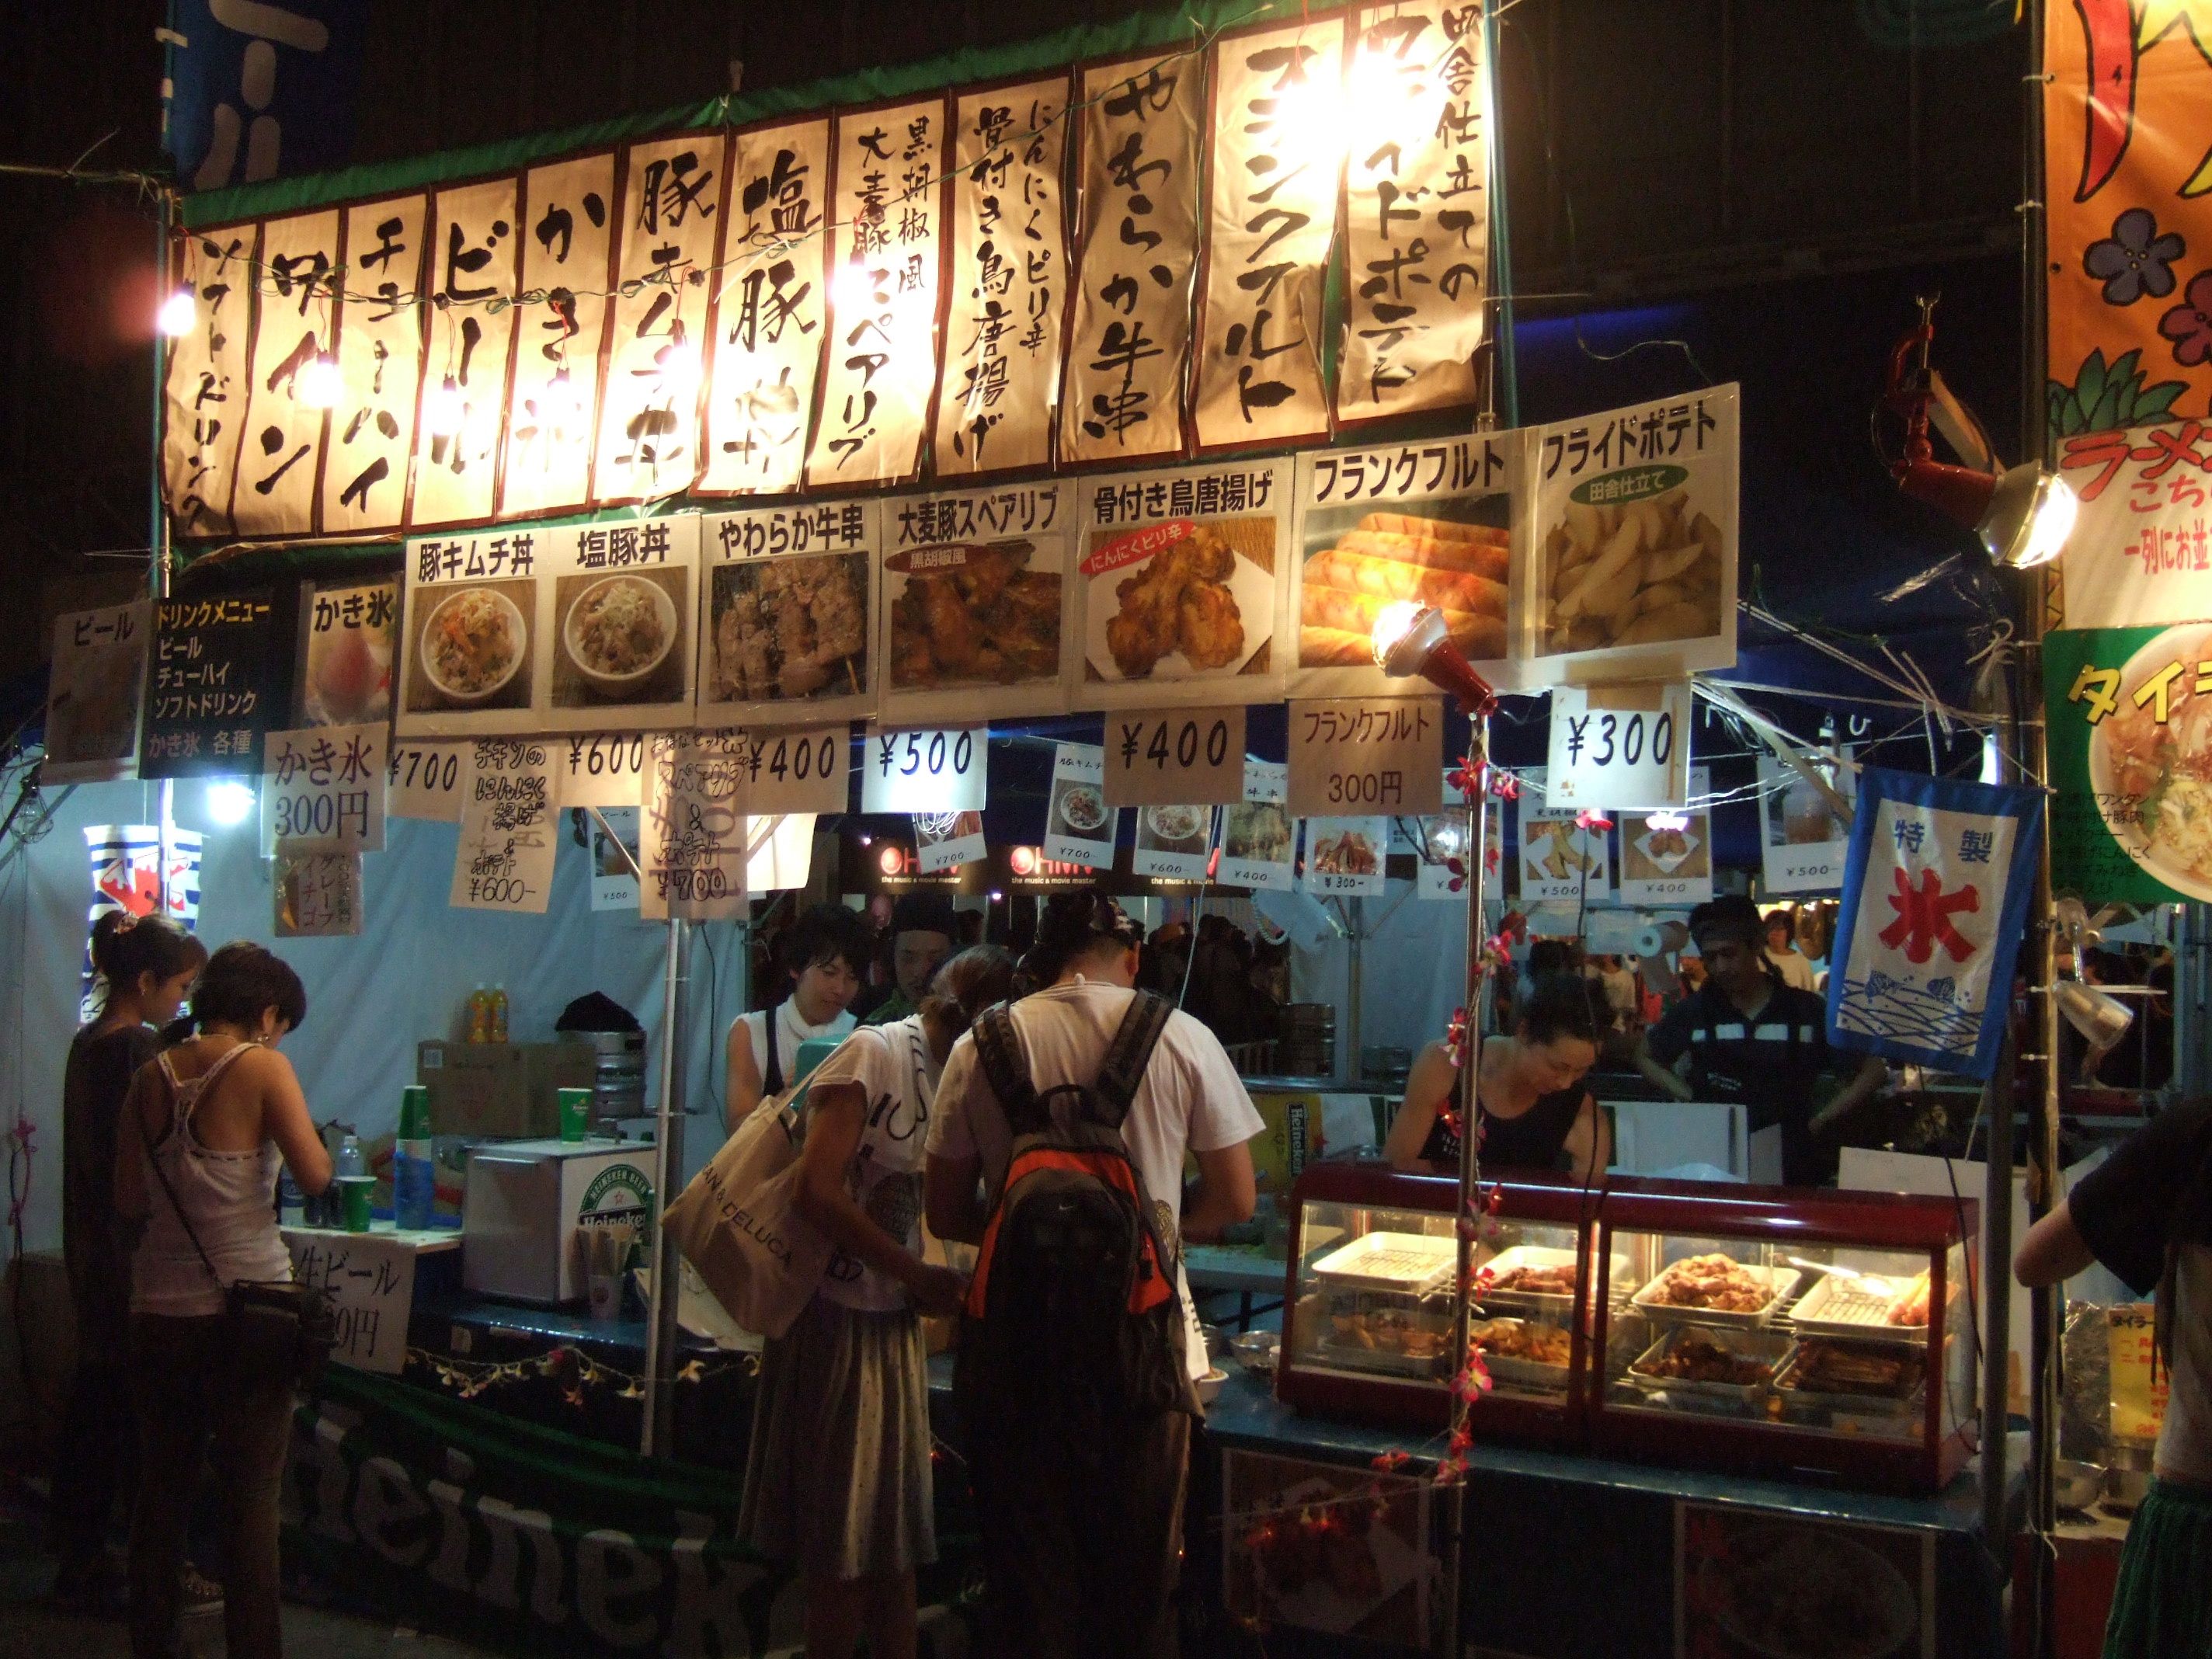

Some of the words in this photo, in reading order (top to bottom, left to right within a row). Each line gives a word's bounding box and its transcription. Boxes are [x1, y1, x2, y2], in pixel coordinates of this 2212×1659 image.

[1435, 5, 1484, 301] 田舎仕立ての
[898, 116, 932, 294] 黒胡椒風
[1019, 100, 1052, 357] にんにくピリ辛
[1359, 16, 1433, 403] フイドポテト
[1083, 71, 1177, 446] やわらか牛串
[1225, 45, 1318, 423] フランクフルト
[954, 107, 1016, 458] 骨付き鳥唐揚げ
[614, 151, 715, 486] 豚キムチ丼
[723, 149, 823, 473] 塩豚丼
[183, 238, 242, 530] ソフトドリンク
[255, 251, 331, 496] ワイン
[339, 217, 405, 513] チューハイ
[1546, 400, 1716, 479] フライドポテト
[2060, 420, 2212, 502] ラーメ
[1094, 469, 1273, 524] 骨付き鳥唐揚げ
[1314, 440, 1504, 502] フランクフルト
[1588, 469, 1664, 503] 田舎仕立て
[2130, 474, 2212, 513] こち
[718, 504, 864, 559] やわらか牛串
[898, 485, 1059, 545] 大麦豚スペアリブ
[419, 534, 534, 583] 豚キムチ丼
[576, 523, 671, 568] 塩豚丼
[909, 548, 967, 569] 黒胡椒風
[1090, 524, 1183, 573] にんにくピリ辛
[2124, 518, 2212, 575] 一列にお並
[74, 610, 134, 647] ビール
[157, 600, 271, 631] ドリンクメニュー
[313, 590, 393, 634] かき氷
[158, 662, 231, 688] チューハイ
[159, 636, 202, 661] ビール
[156, 690, 256, 719] ソフトドリンク
[1305, 708, 1430, 744] フランクフルト
[274, 733, 372, 787] かき氷
[569, 733, 644, 775] ¥600
[750, 735, 835, 783] ¥400
[879, 730, 972, 777] ¥500
[1122, 718, 1228, 770] ¥400
[1567, 712, 1672, 767] ¥300
[389, 750, 457, 791] ¥700
[475, 777, 546, 801] にんにく
[1328, 770, 1403, 805] 300円
[274, 790, 369, 839] 300円
[1878, 867, 1981, 964] 氷
[584, 1211, 646, 1229] Heineke
